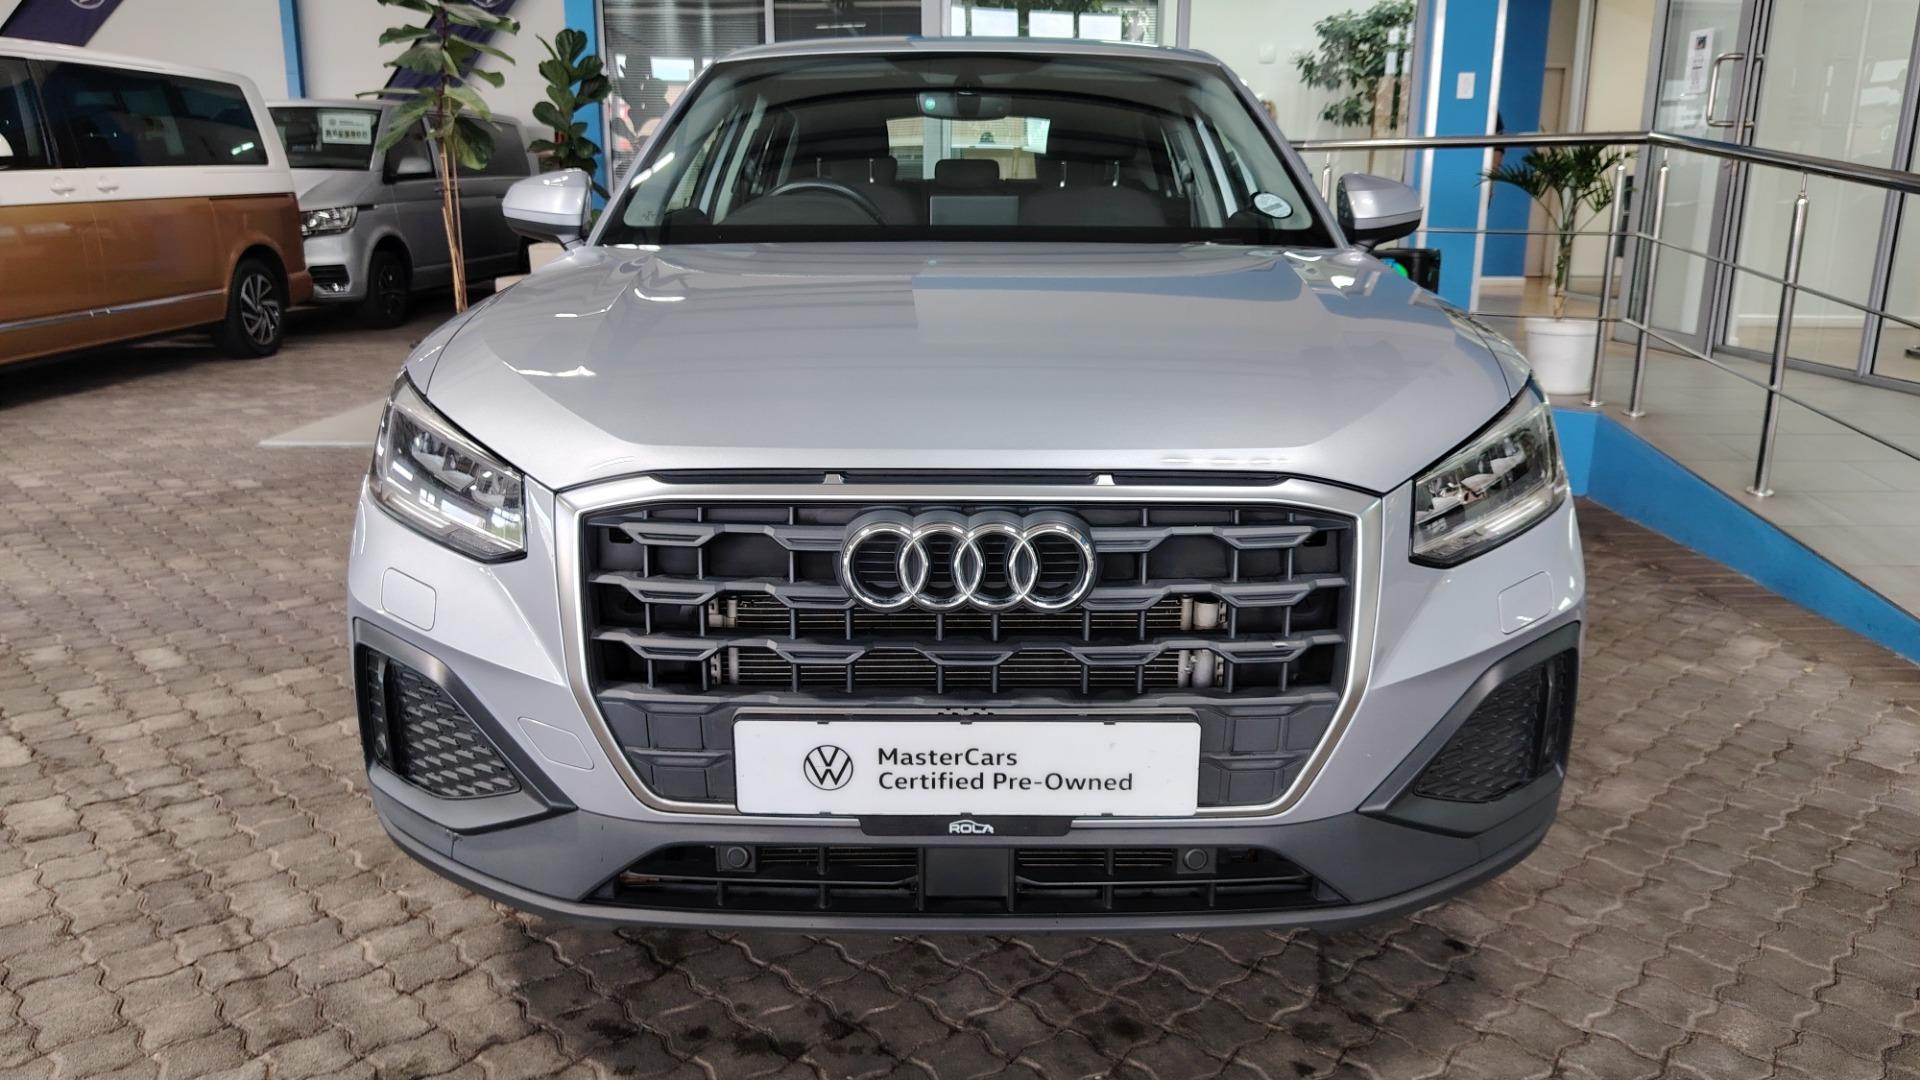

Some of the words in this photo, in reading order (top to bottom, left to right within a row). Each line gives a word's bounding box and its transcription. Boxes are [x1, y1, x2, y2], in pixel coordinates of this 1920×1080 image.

[878, 747, 1018, 766] MasterCars
[878, 771, 984, 790] Certified
[993, 772, 1133, 791] Pre-Owned
[949, 821, 995, 834] ROLA
